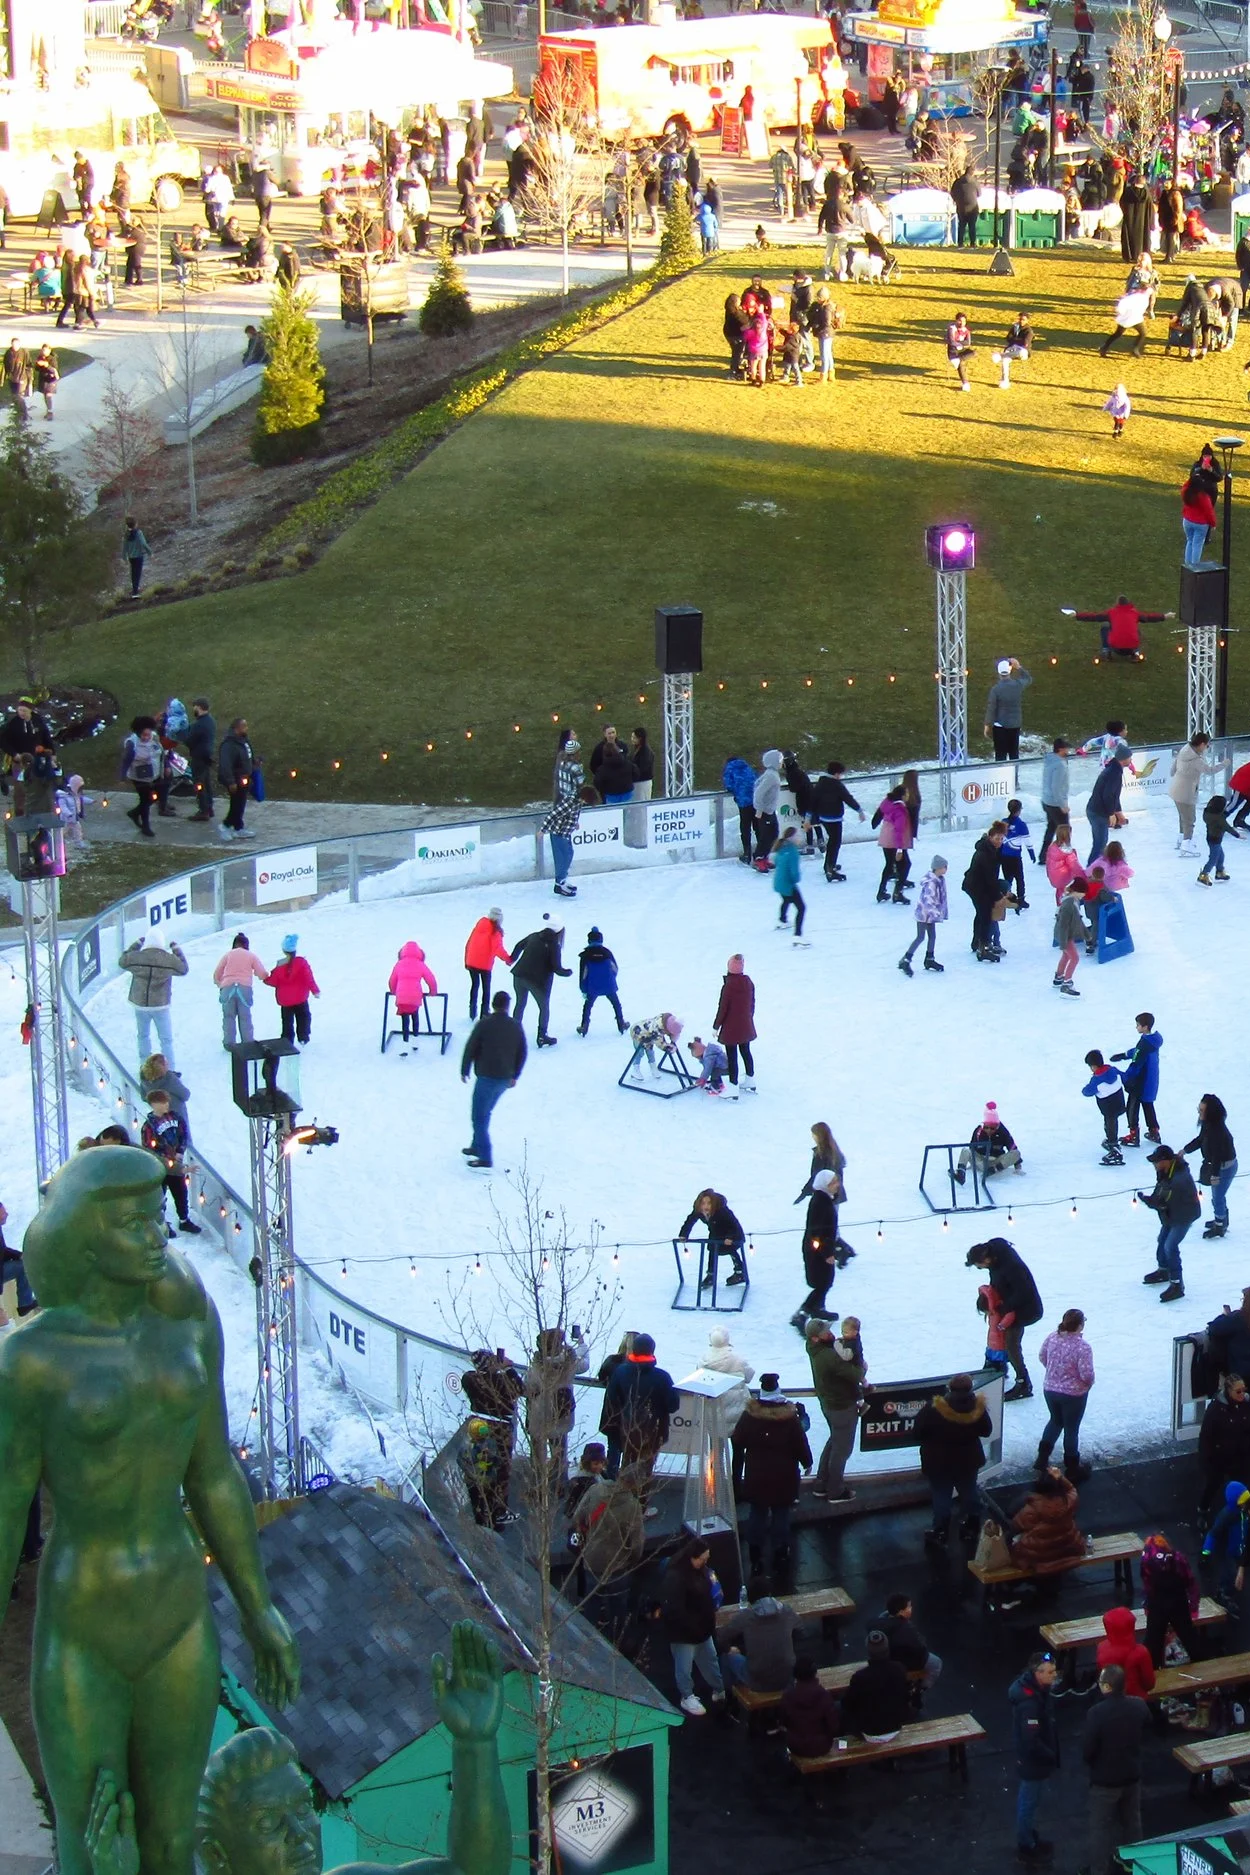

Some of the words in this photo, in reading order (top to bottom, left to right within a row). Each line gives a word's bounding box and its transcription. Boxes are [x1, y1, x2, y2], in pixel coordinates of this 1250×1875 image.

[983, 781, 1009, 797] HOTEL
[652, 808, 695, 821] HENRY
[655, 821, 686, 833] FORD
[655, 831, 702, 844] HEALTH
[426, 847, 468, 860] OAKLAND
[271, 868, 295, 881] Royal
[296, 866, 314, 876] Oak
[150, 893, 188, 927] DTE
[330, 1311, 365, 1355] DTE
[866, 1421, 900, 1434] EXIT
[577, 1801, 605, 1822] M3
[568, 1816, 612, 1831] INVESTMENT
[574, 1823, 606, 1835] SERVICES
[1181, 1844, 1213, 1873] HENRY
